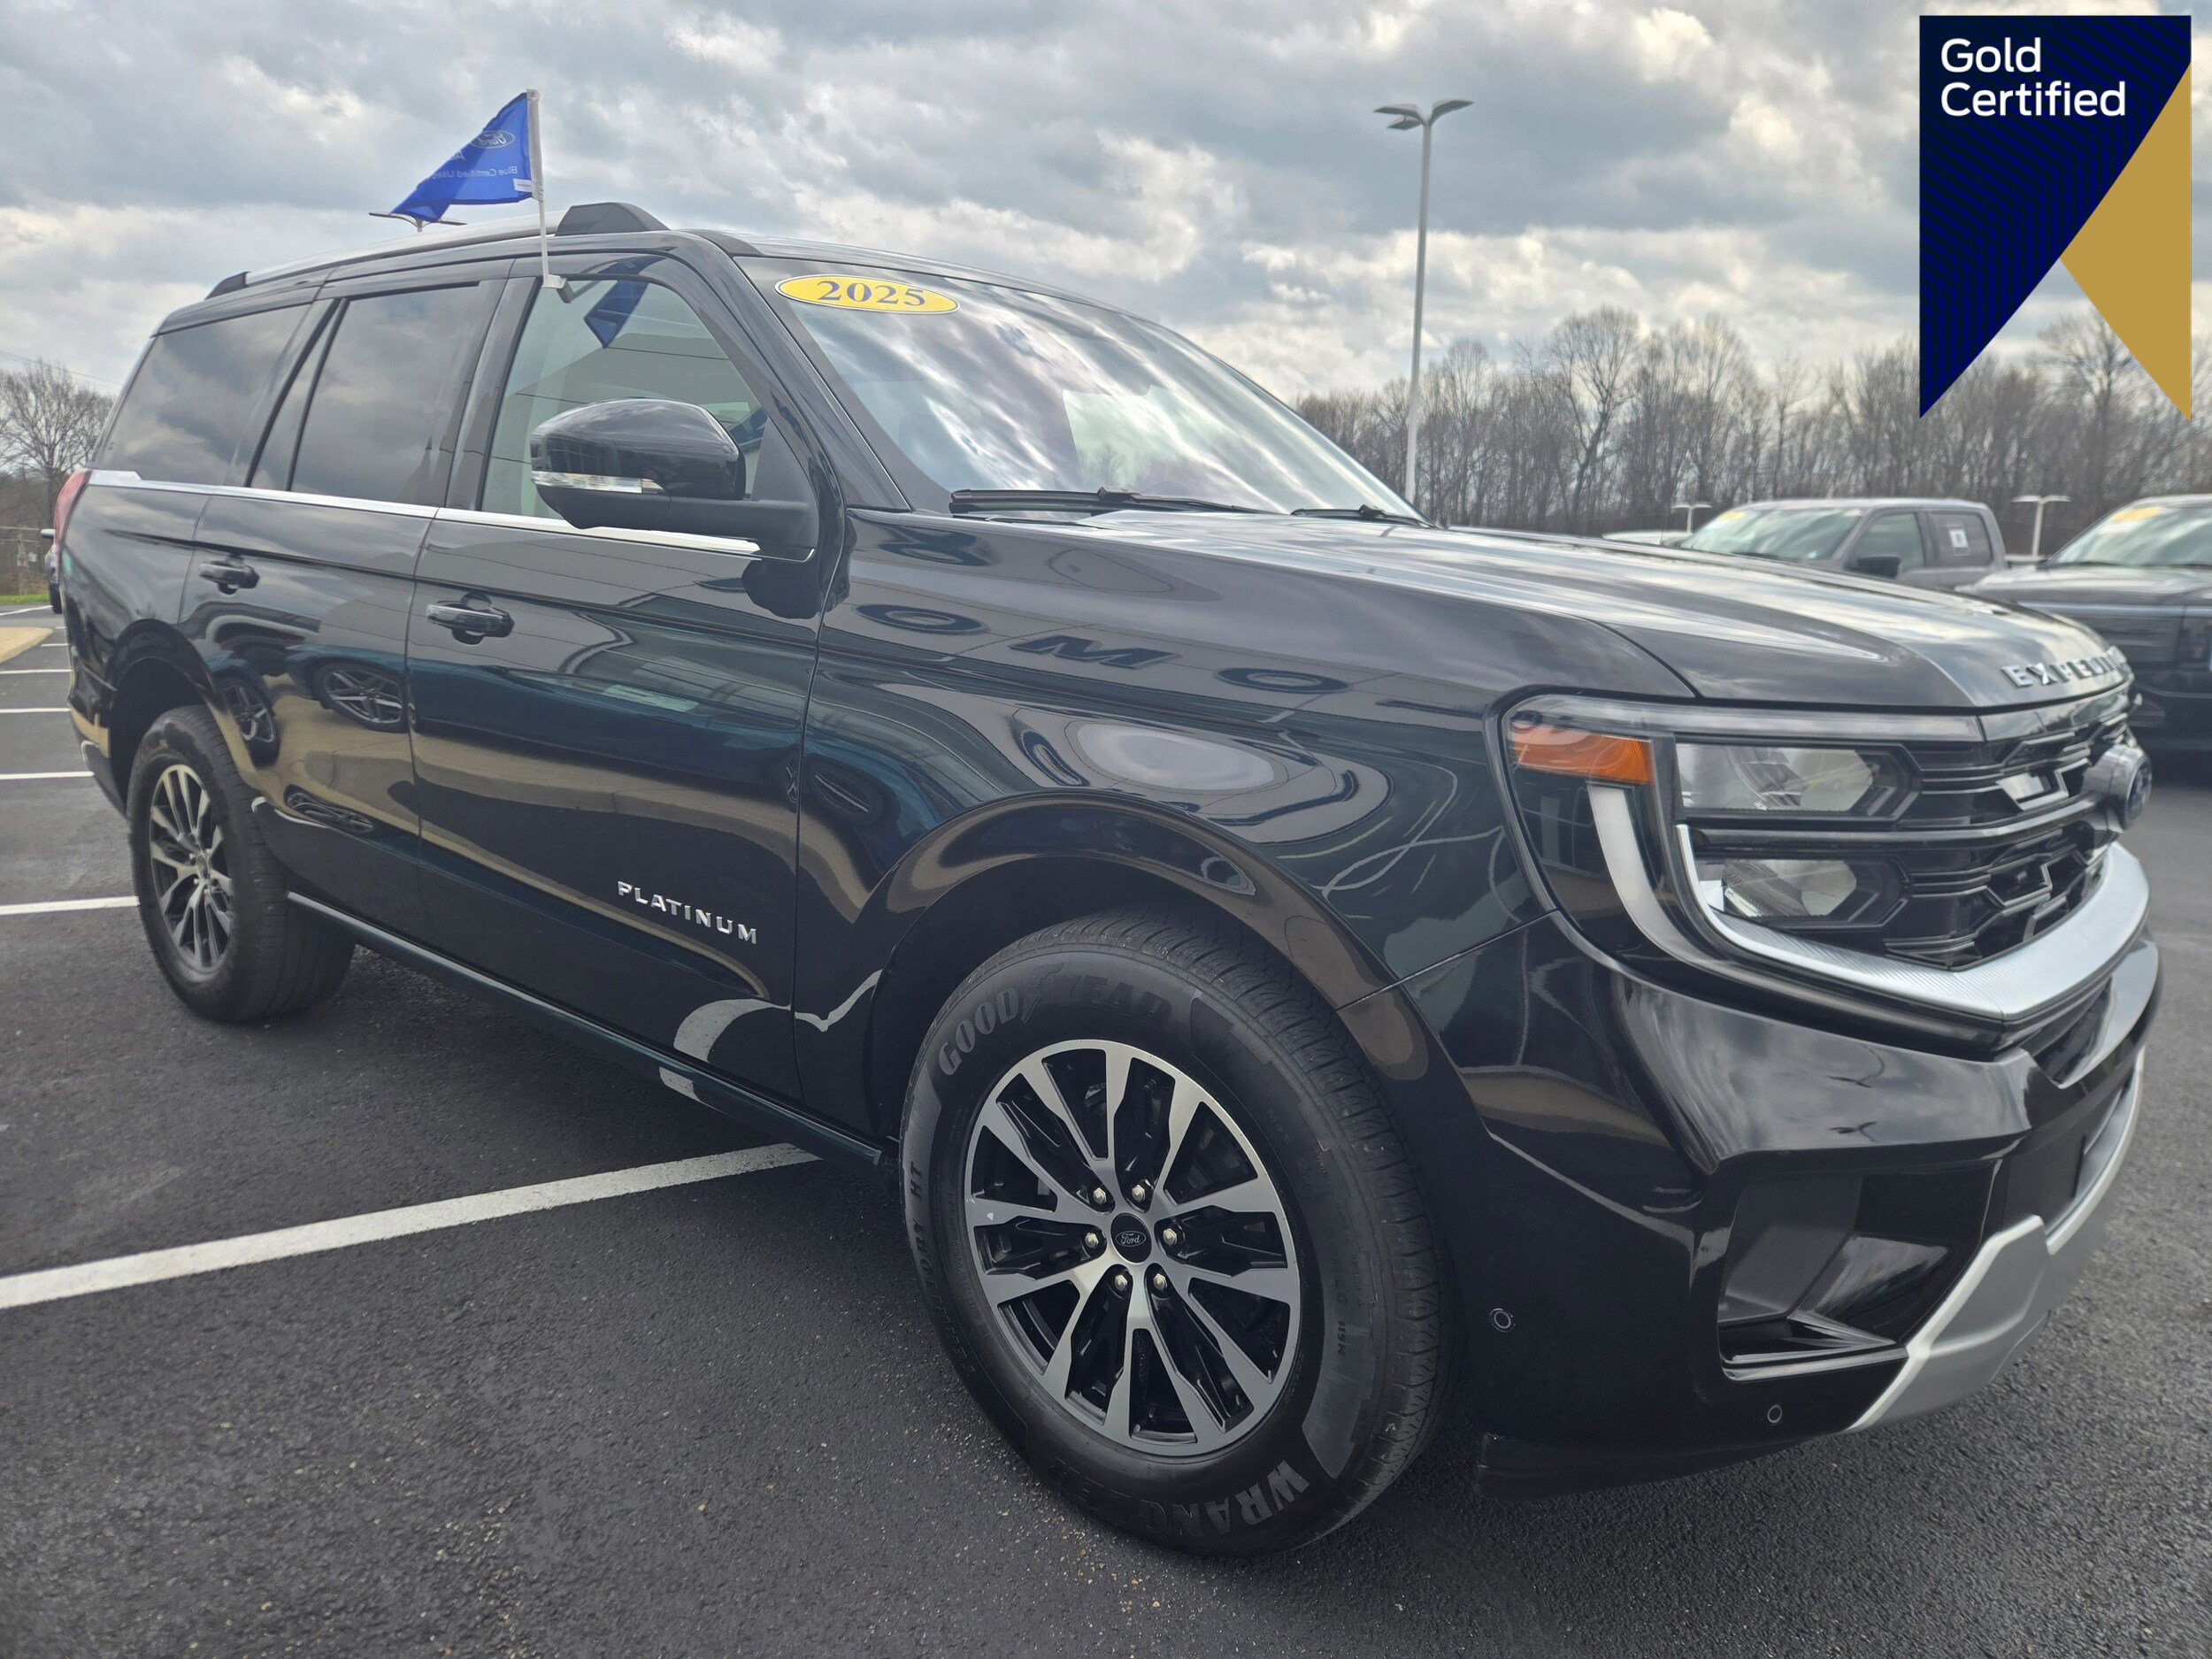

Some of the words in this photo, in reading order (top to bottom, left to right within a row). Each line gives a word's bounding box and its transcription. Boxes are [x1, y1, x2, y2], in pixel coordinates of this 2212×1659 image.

[817, 280, 926, 307] 2025
[618, 880, 757, 944] PLATINUM
[1120, 1233, 1141, 1245] Ford
